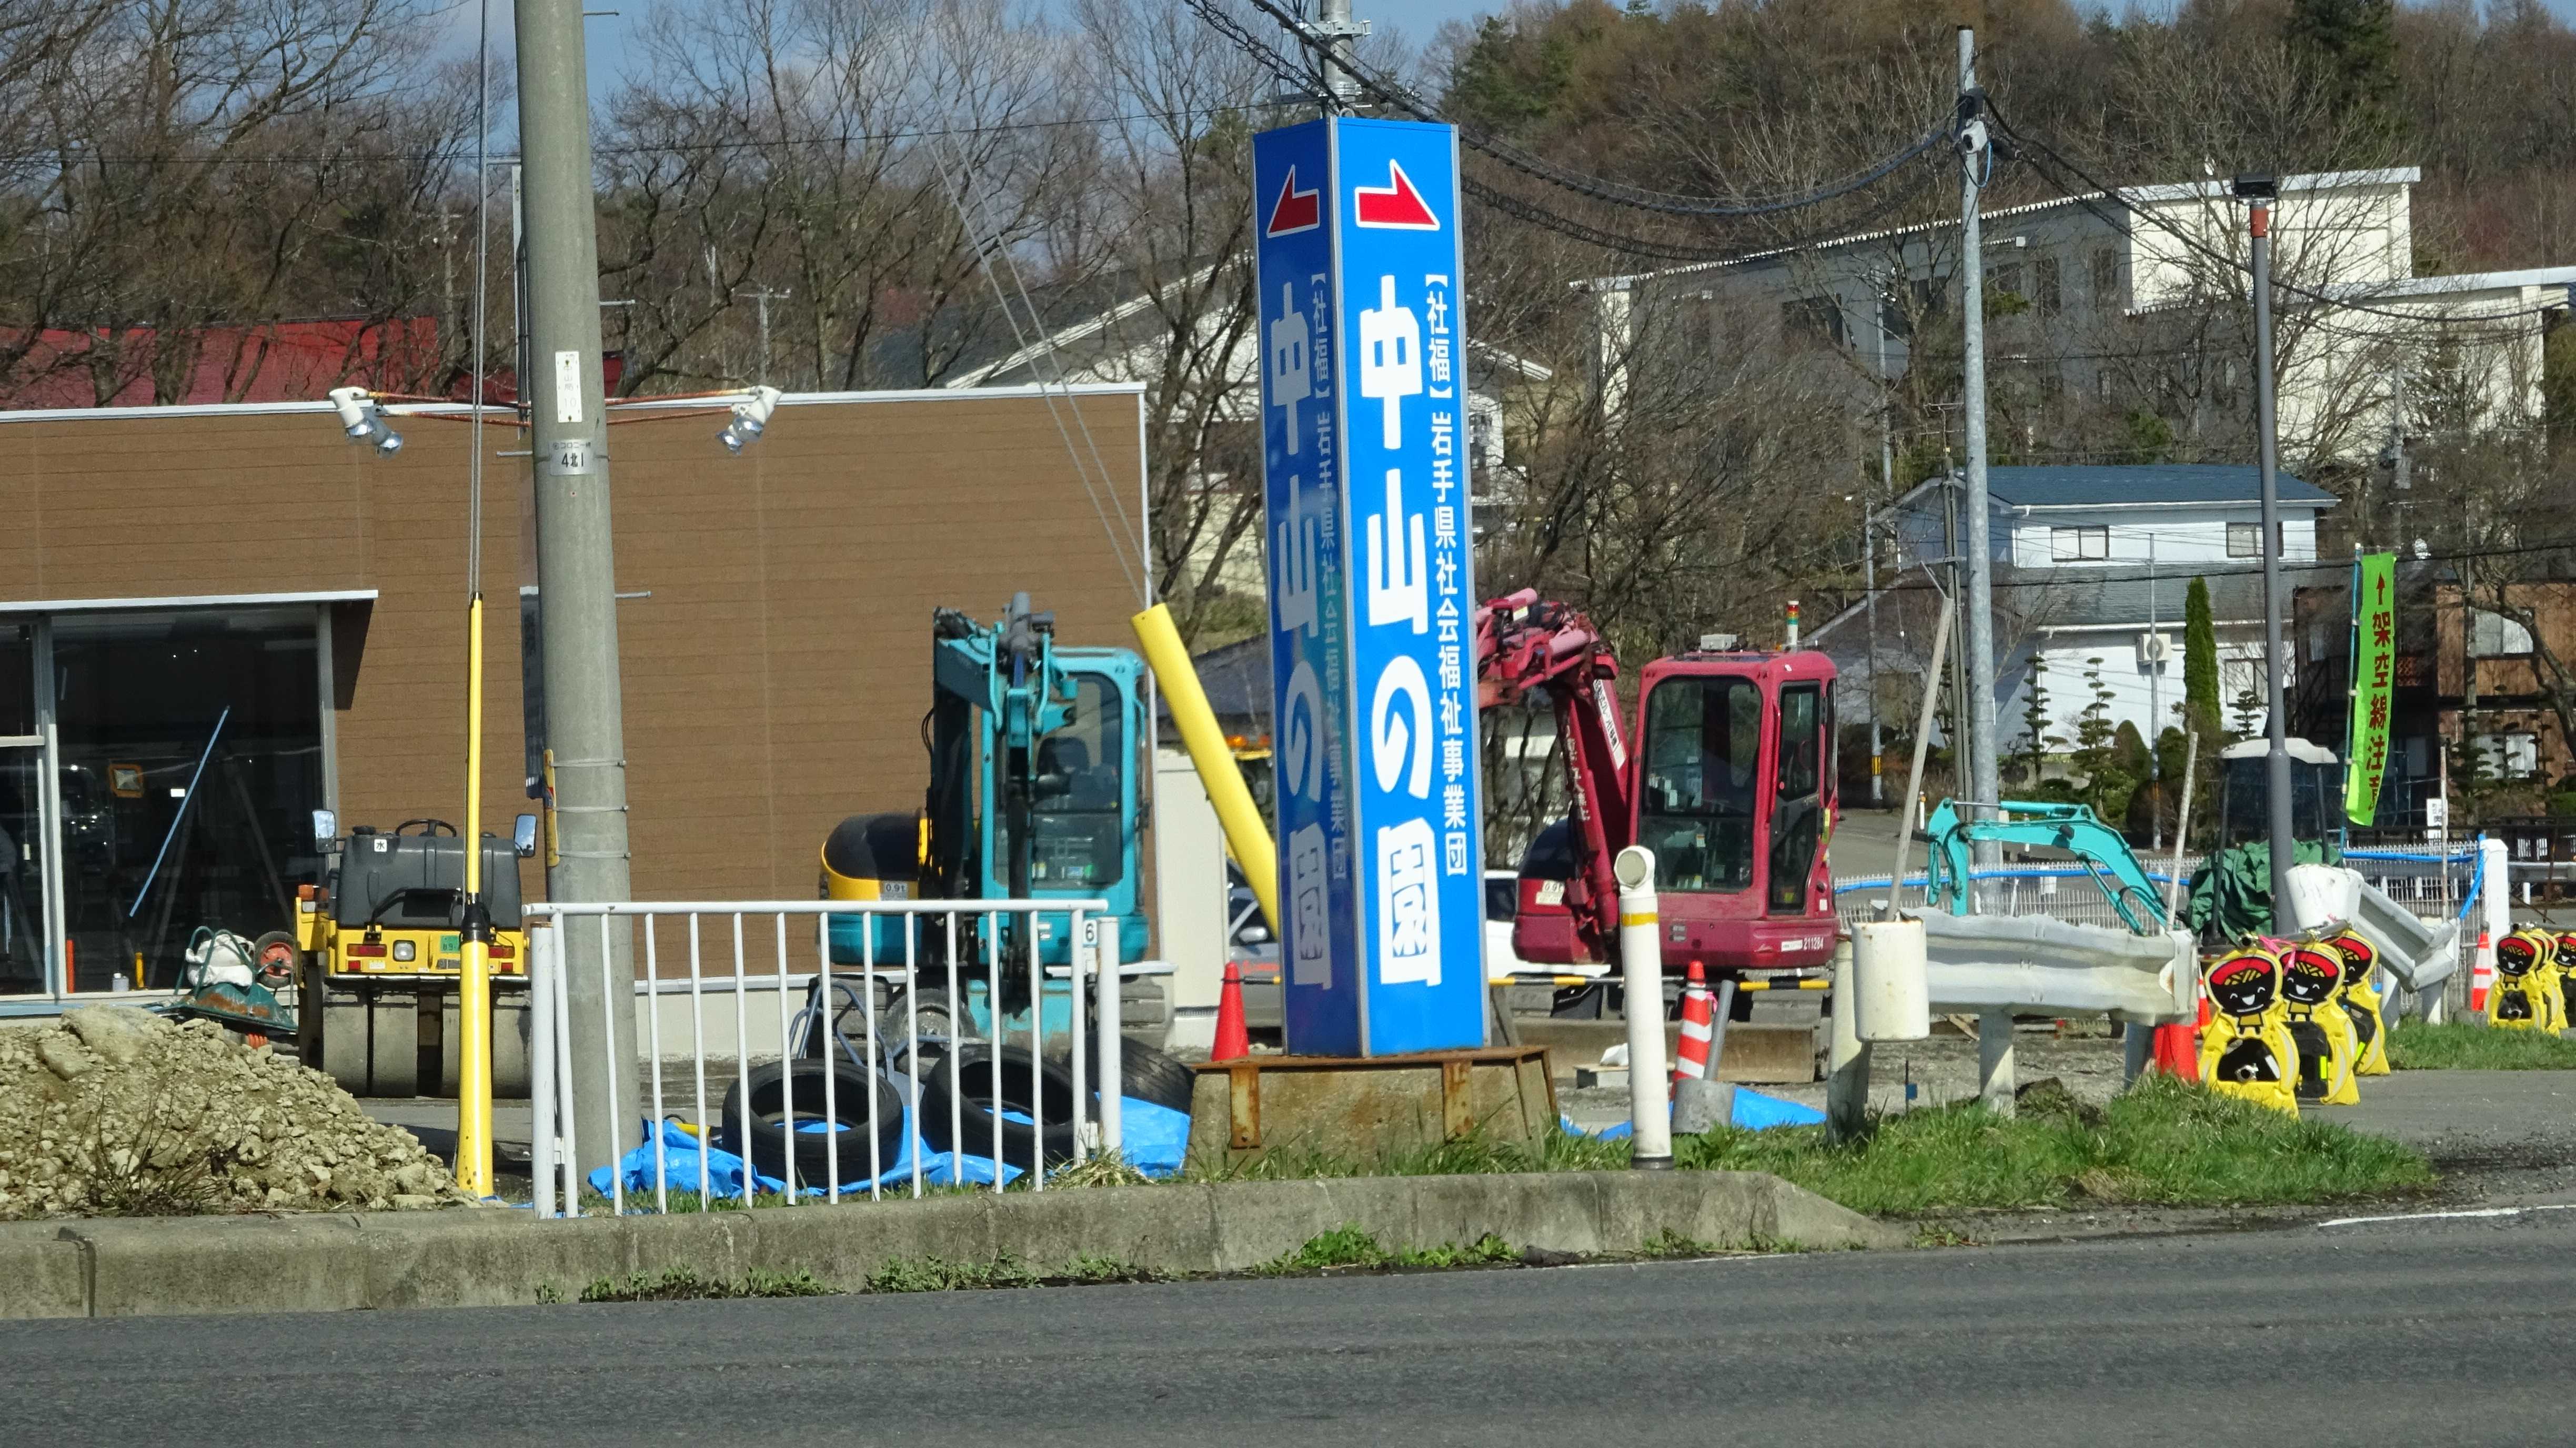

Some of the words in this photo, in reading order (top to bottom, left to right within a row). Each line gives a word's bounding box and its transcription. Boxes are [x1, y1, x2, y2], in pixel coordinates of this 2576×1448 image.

[376, 841, 385, 850] 水
[1271, 282, 1332, 989] 中山の園
[1359, 275, 1442, 987] 中山の園
[1425, 274, 1468, 877] 【社福】岩手県社会福祉事業団
[1085, 923, 1095, 942] 6
